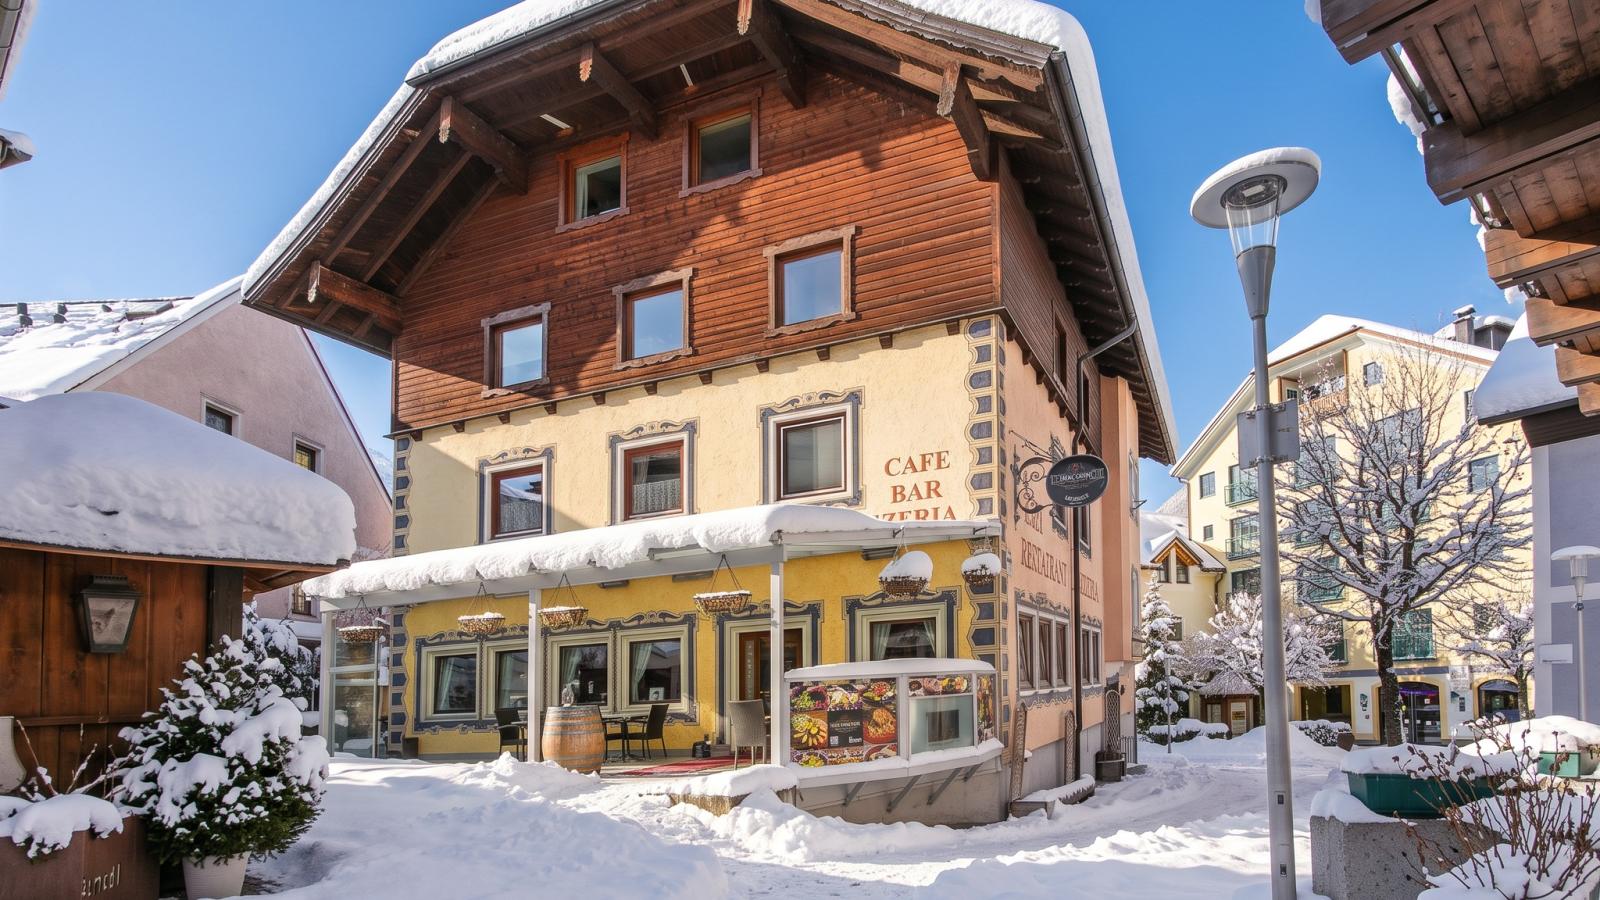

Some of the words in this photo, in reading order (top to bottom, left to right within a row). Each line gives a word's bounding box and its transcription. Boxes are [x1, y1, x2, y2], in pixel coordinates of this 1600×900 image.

[884, 450, 950, 476] CAFE
[890, 480, 943, 504] BAR
[873, 505, 956, 521] ZERIA
